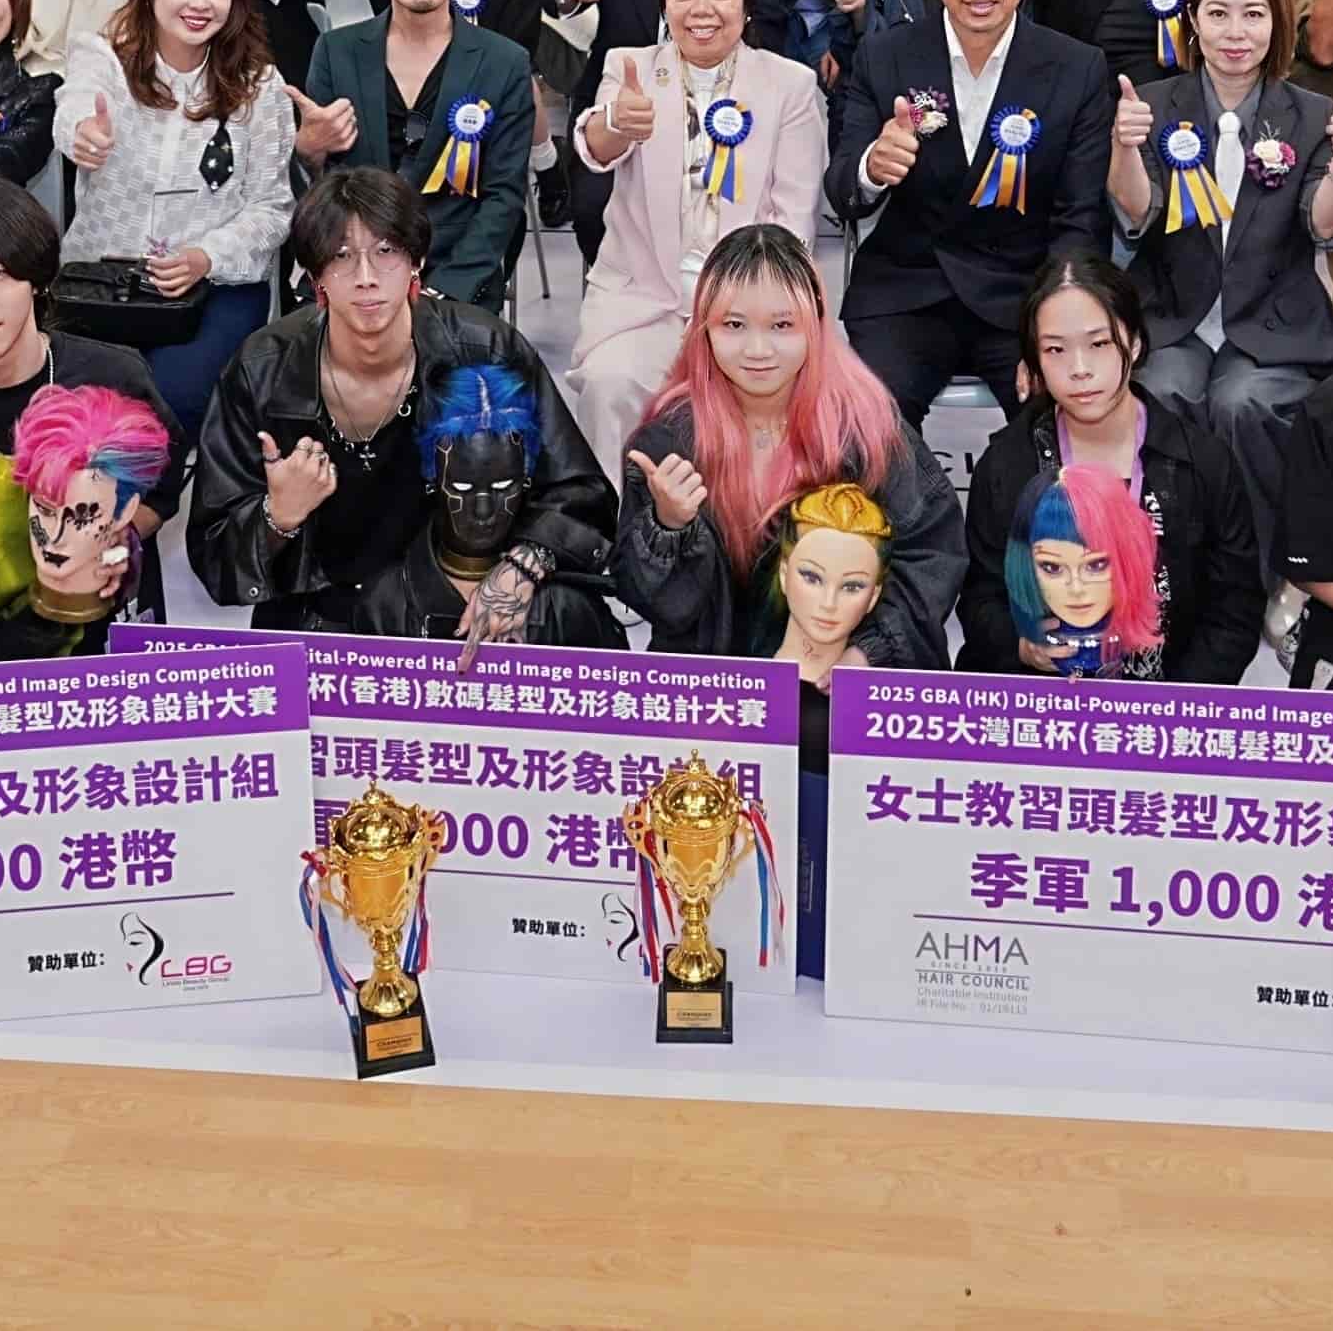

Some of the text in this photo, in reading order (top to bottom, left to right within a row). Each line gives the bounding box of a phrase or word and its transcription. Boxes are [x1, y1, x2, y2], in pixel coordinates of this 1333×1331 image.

[22, 673, 80, 696] Image
[86, 669, 151, 691] Design
[155, 662, 275, 686] Competition
[476, 658, 510, 675] and
[516, 661, 573, 681] Image
[578, 665, 642, 685] Design
[647, 668, 766, 692] Competition
[868, 685, 915, 703] 2025
[920, 687, 960, 705] GBA
[966, 690, 1009, 710] (HK)
[1015, 692, 1175, 718] Digital-Powered
[1182, 701, 1224, 719] Hair
[1229, 704, 1266, 721] and
[1272, 706, 1333, 728] Image
[58, 828, 177, 891] 港幣
[970, 852, 1090, 914] 季軍
[1109, 865, 1280, 927] 1,000
[915, 930, 1030, 966] AHMA
[918, 972, 1030, 991] HAIR COUNCIL
